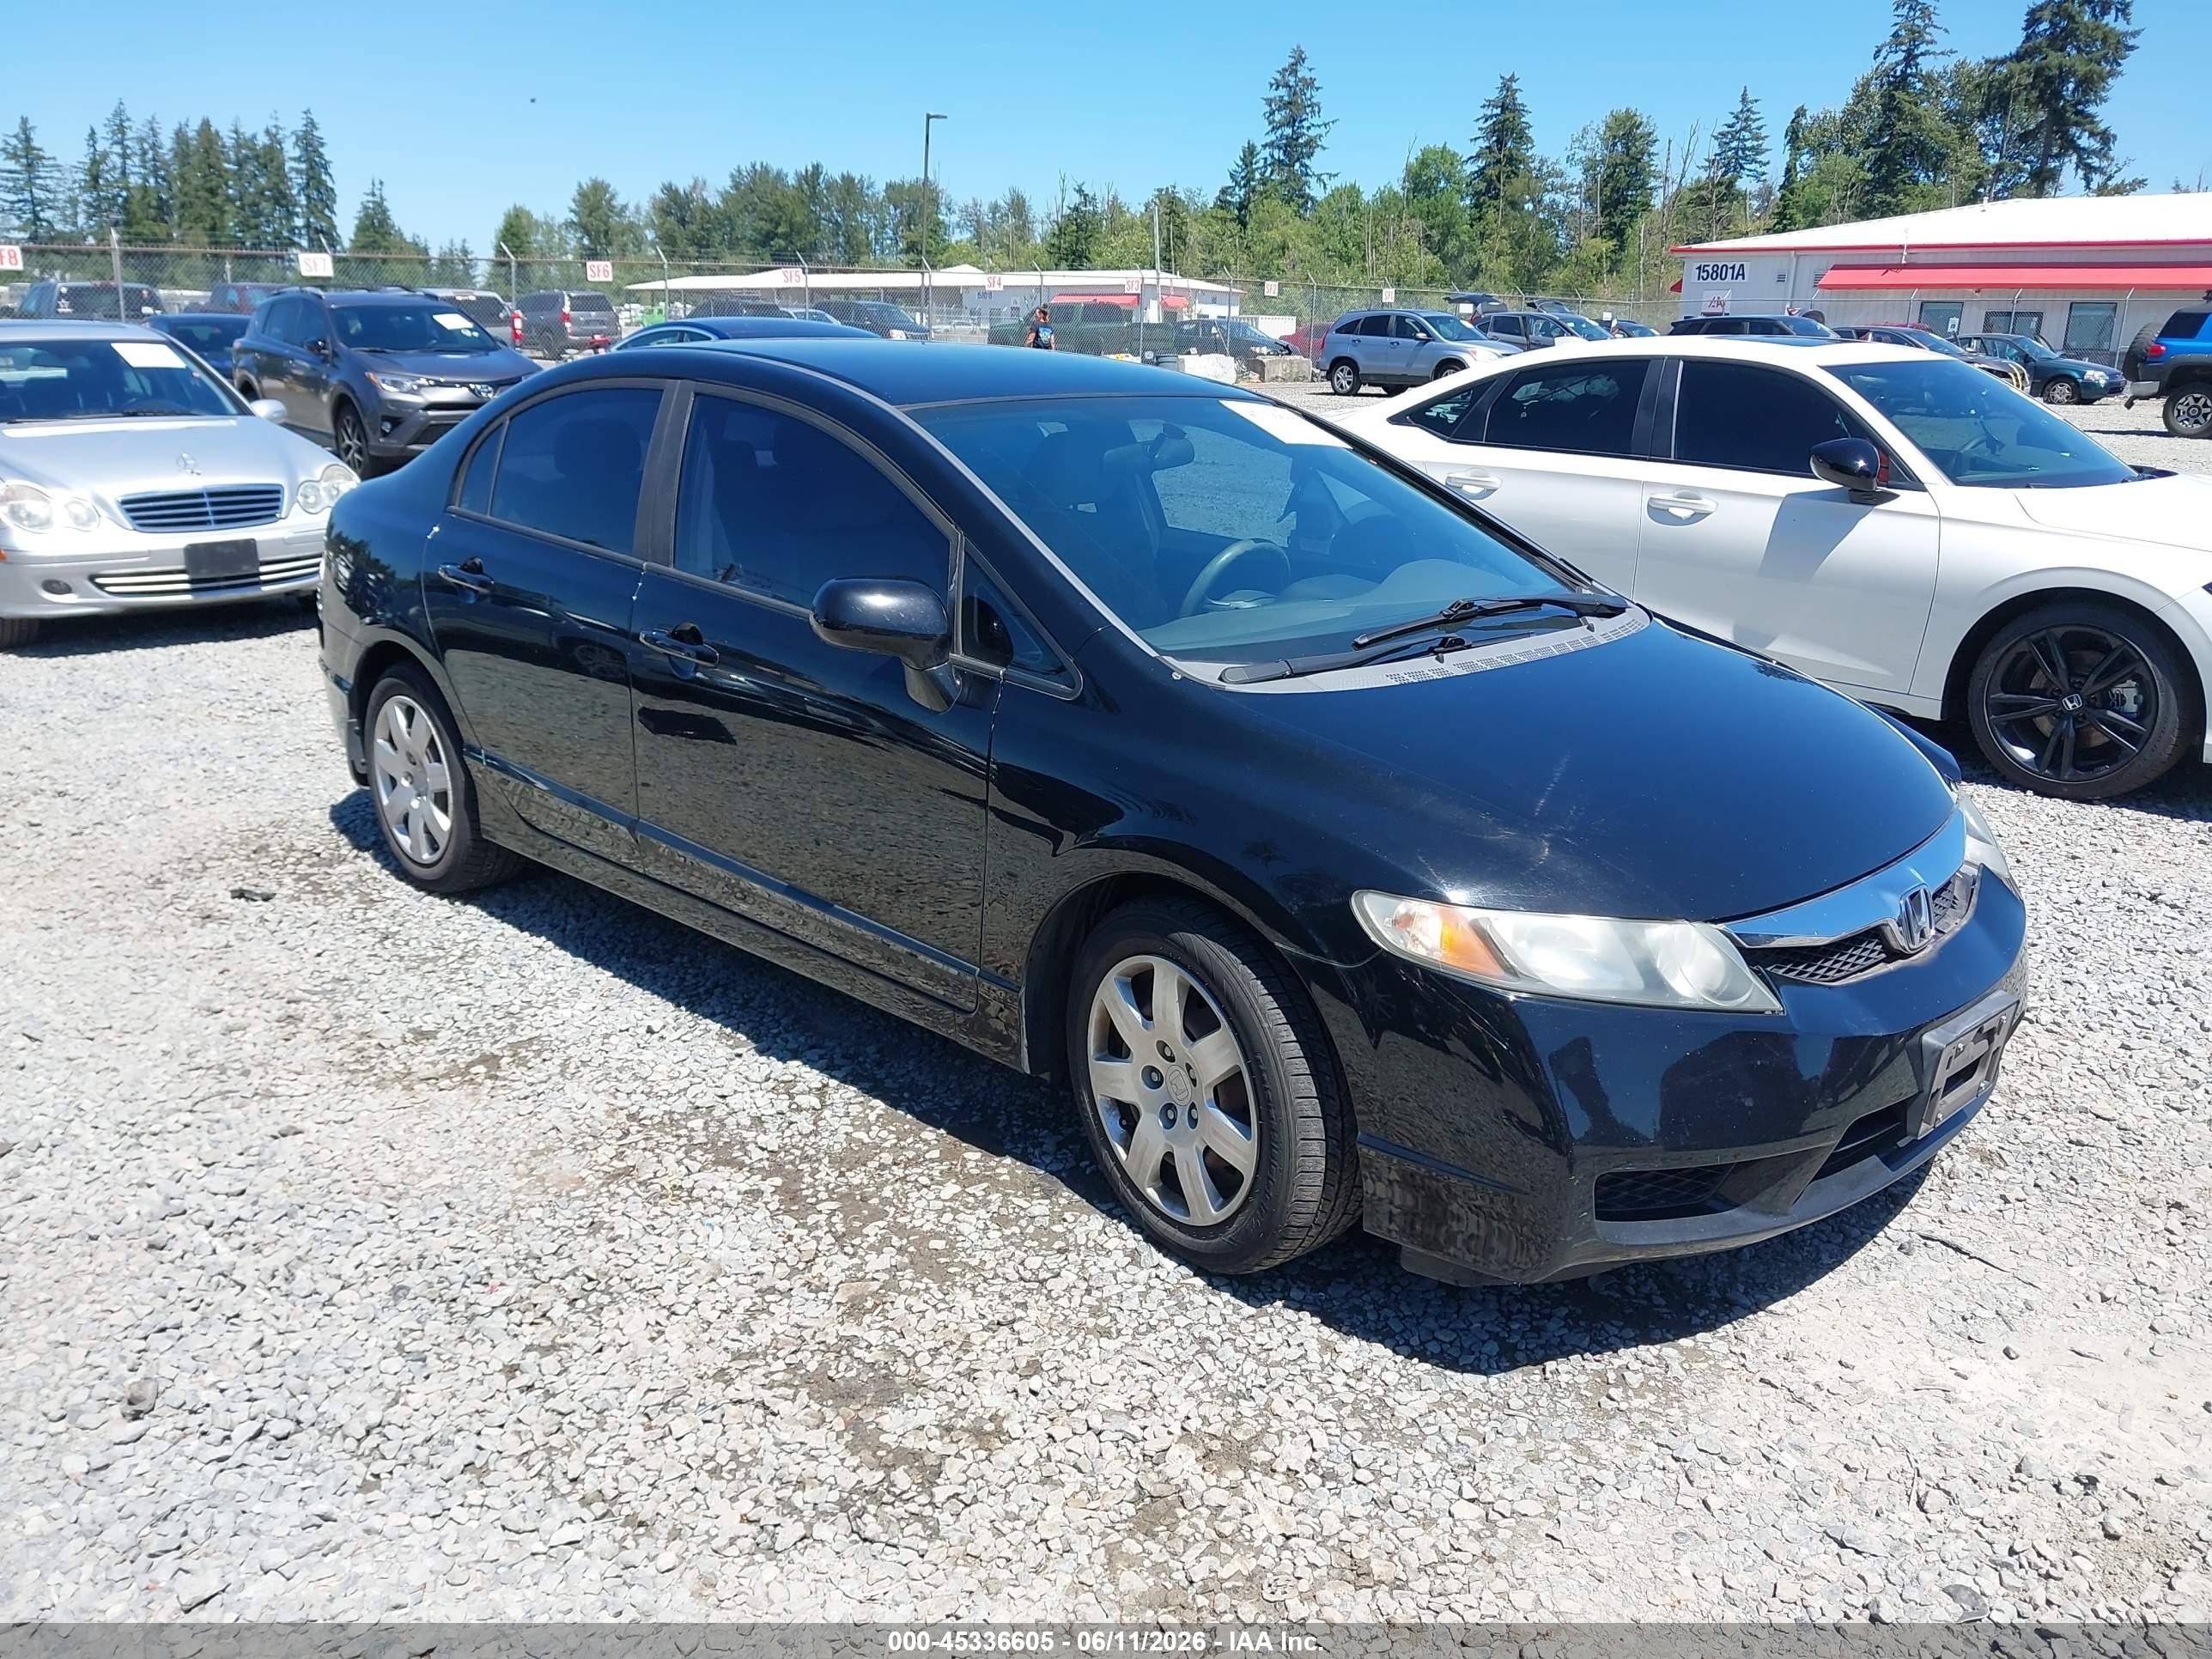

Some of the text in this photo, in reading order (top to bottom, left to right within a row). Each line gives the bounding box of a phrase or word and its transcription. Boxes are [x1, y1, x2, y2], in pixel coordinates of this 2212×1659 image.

[303, 257, 326, 273] SF7
[588, 264, 610, 279] SF6
[782, 270, 801, 283] SF5
[1695, 264, 1745, 282] 15801A
[987, 276, 1002, 289] SF4
[1126, 280, 1140, 291] SF3
[1266, 283, 1277, 295] SF2
